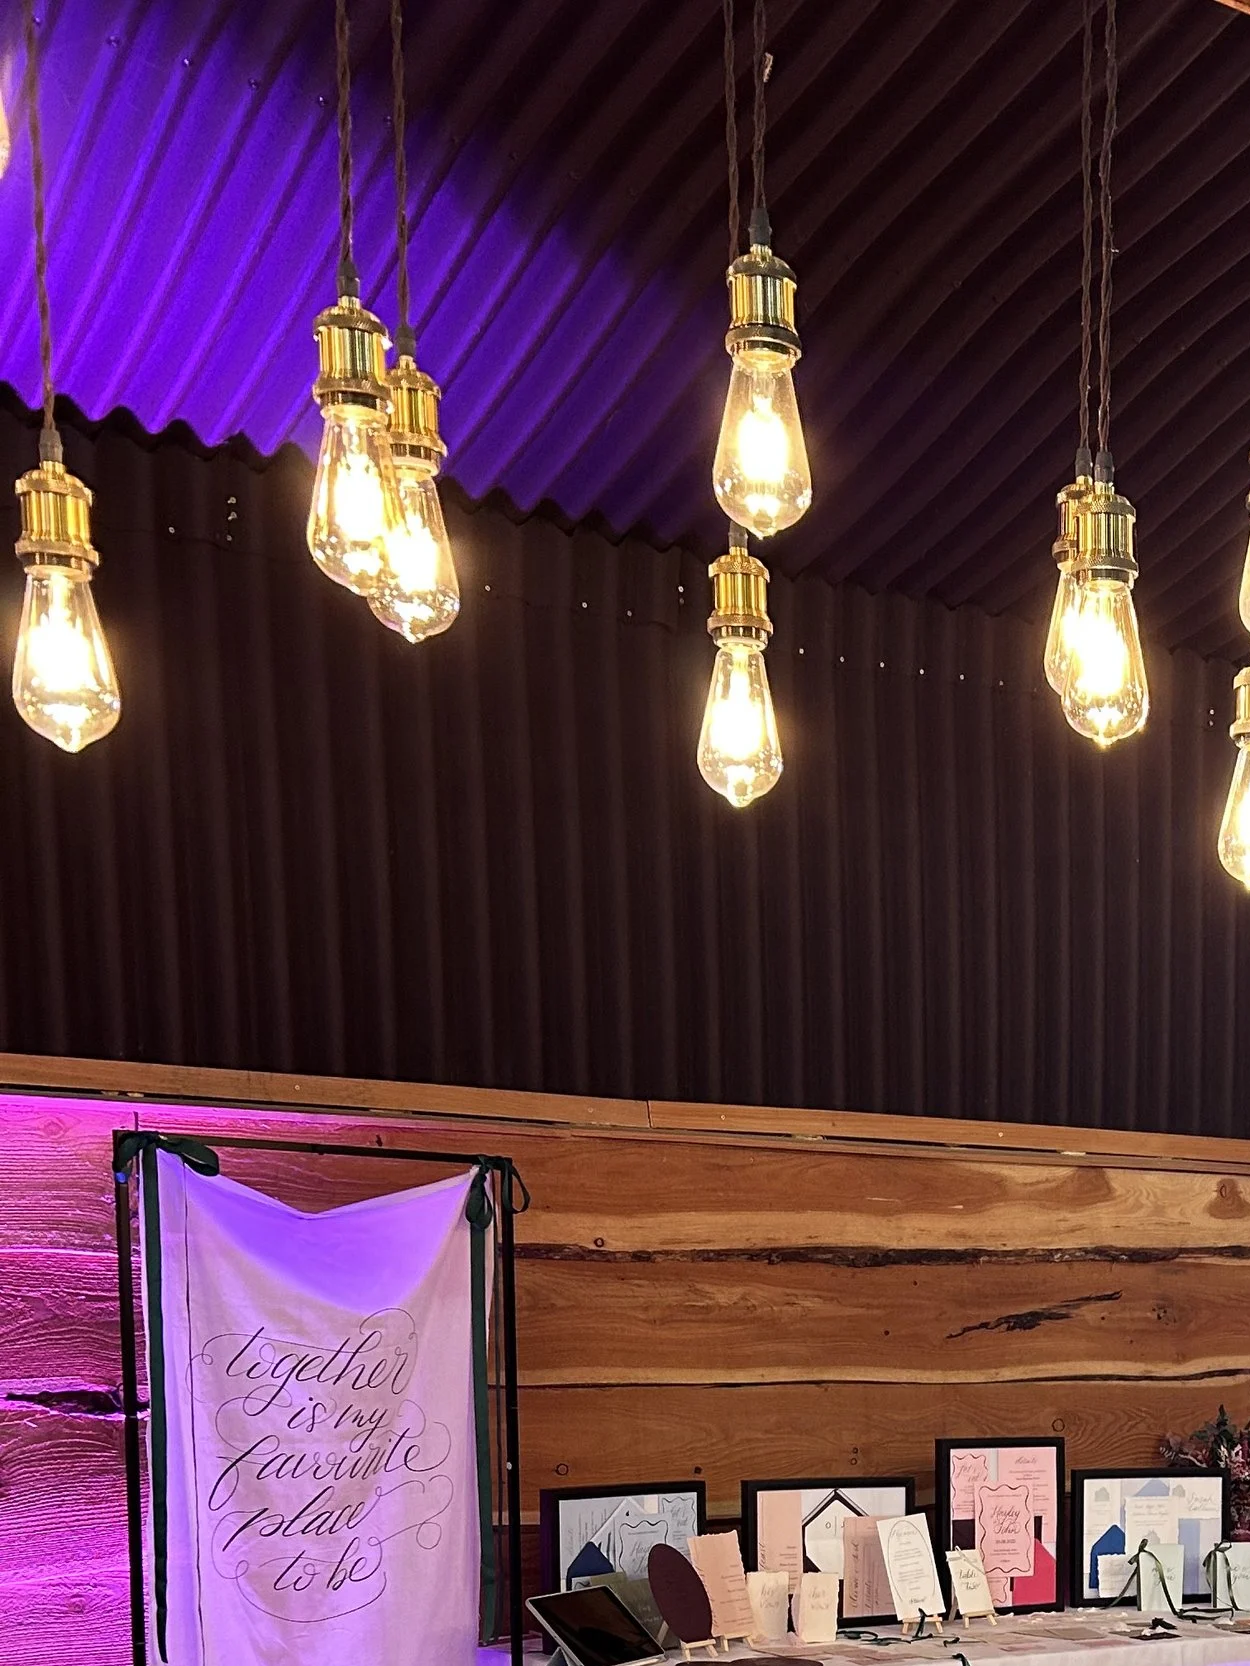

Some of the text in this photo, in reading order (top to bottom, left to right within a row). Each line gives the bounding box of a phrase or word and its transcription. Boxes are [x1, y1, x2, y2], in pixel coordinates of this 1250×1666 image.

[215, 1324, 416, 1417] together
[286, 1396, 391, 1454] is my
[208, 1427, 432, 1512] favourite
[272, 1535, 384, 1592] to be
